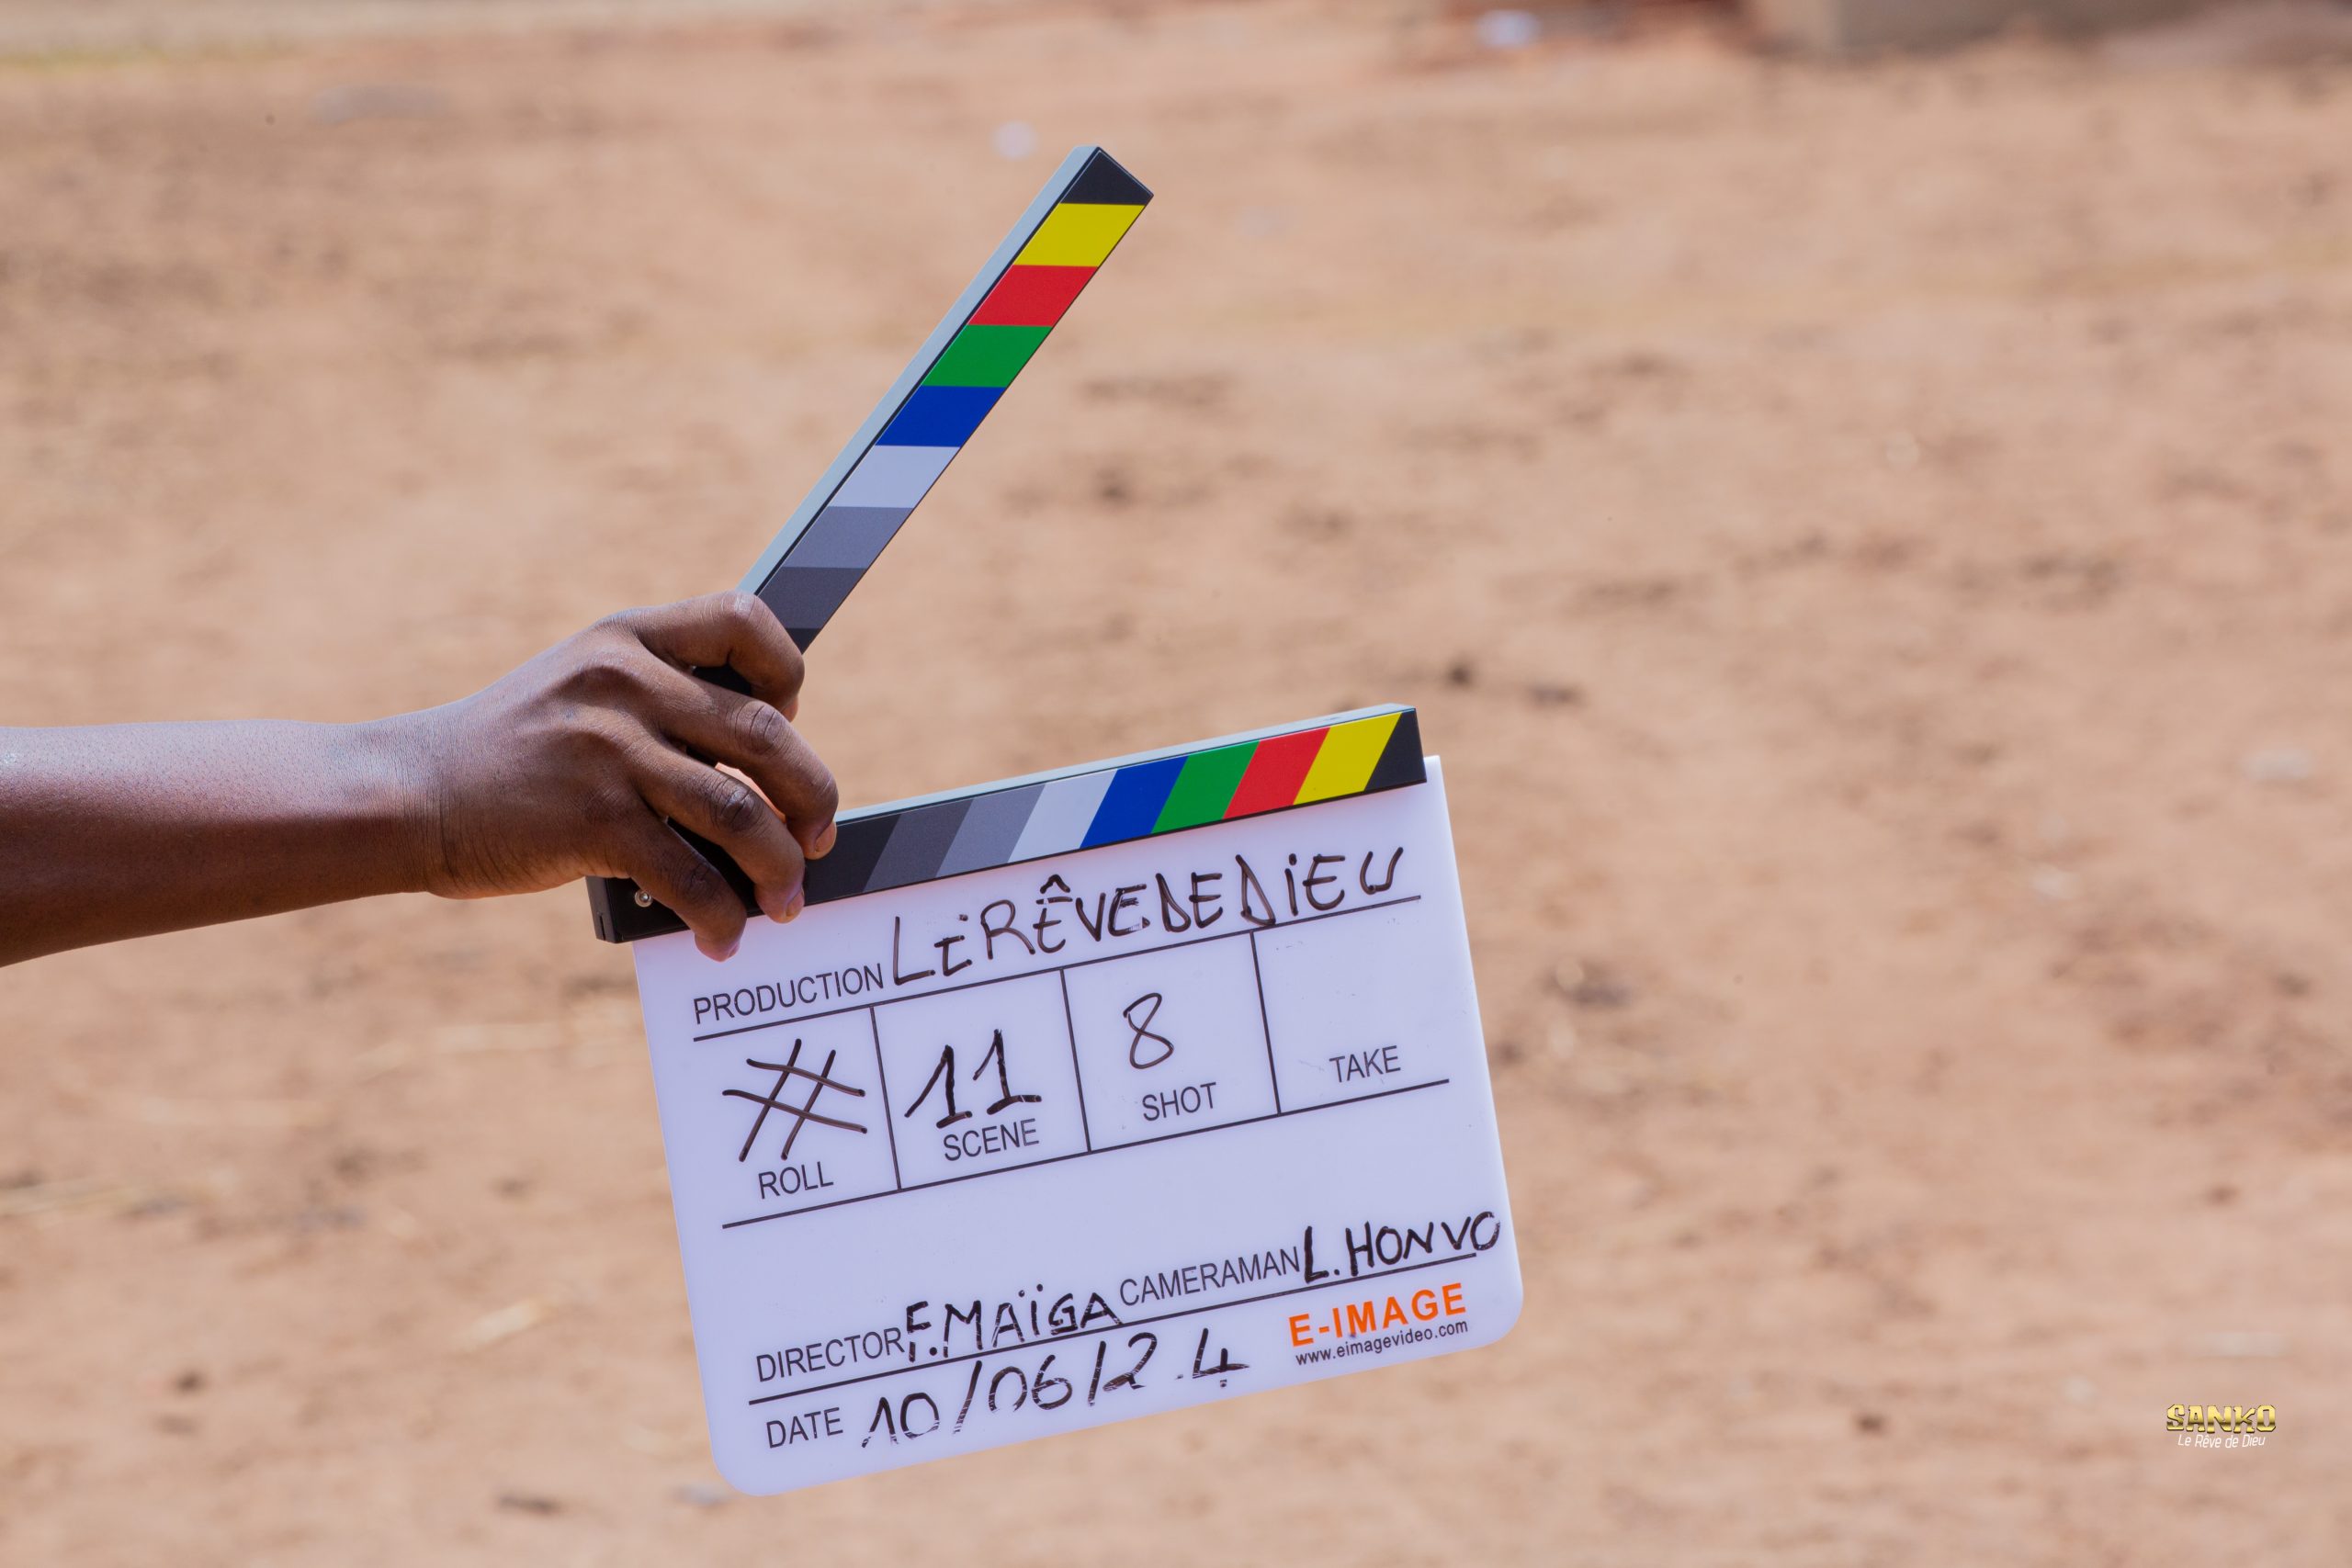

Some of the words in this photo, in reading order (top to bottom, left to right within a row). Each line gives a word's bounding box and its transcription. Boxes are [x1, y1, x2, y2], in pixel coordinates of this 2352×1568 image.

[693, 963, 884, 1025] PRODUCTION
[1122, 992, 1175, 1070] 8
[903, 1028, 1043, 1130] 11
[1329, 1044, 1401, 1083] TAKE
[1141, 1081, 1216, 1122] SHOT
[943, 1117, 1040, 1162] SCENE
[758, 1160, 834, 1200] ROLL
[1119, 1246, 1300, 1306] CAMERAMAN
[1289, 1282, 1466, 1347] E-IMAGE
[755, 1326, 906, 1382] DIRECTOR
[1295, 1319, 1468, 1366] www.eimagevideo.com
[765, 1406, 843, 1449] DATE
